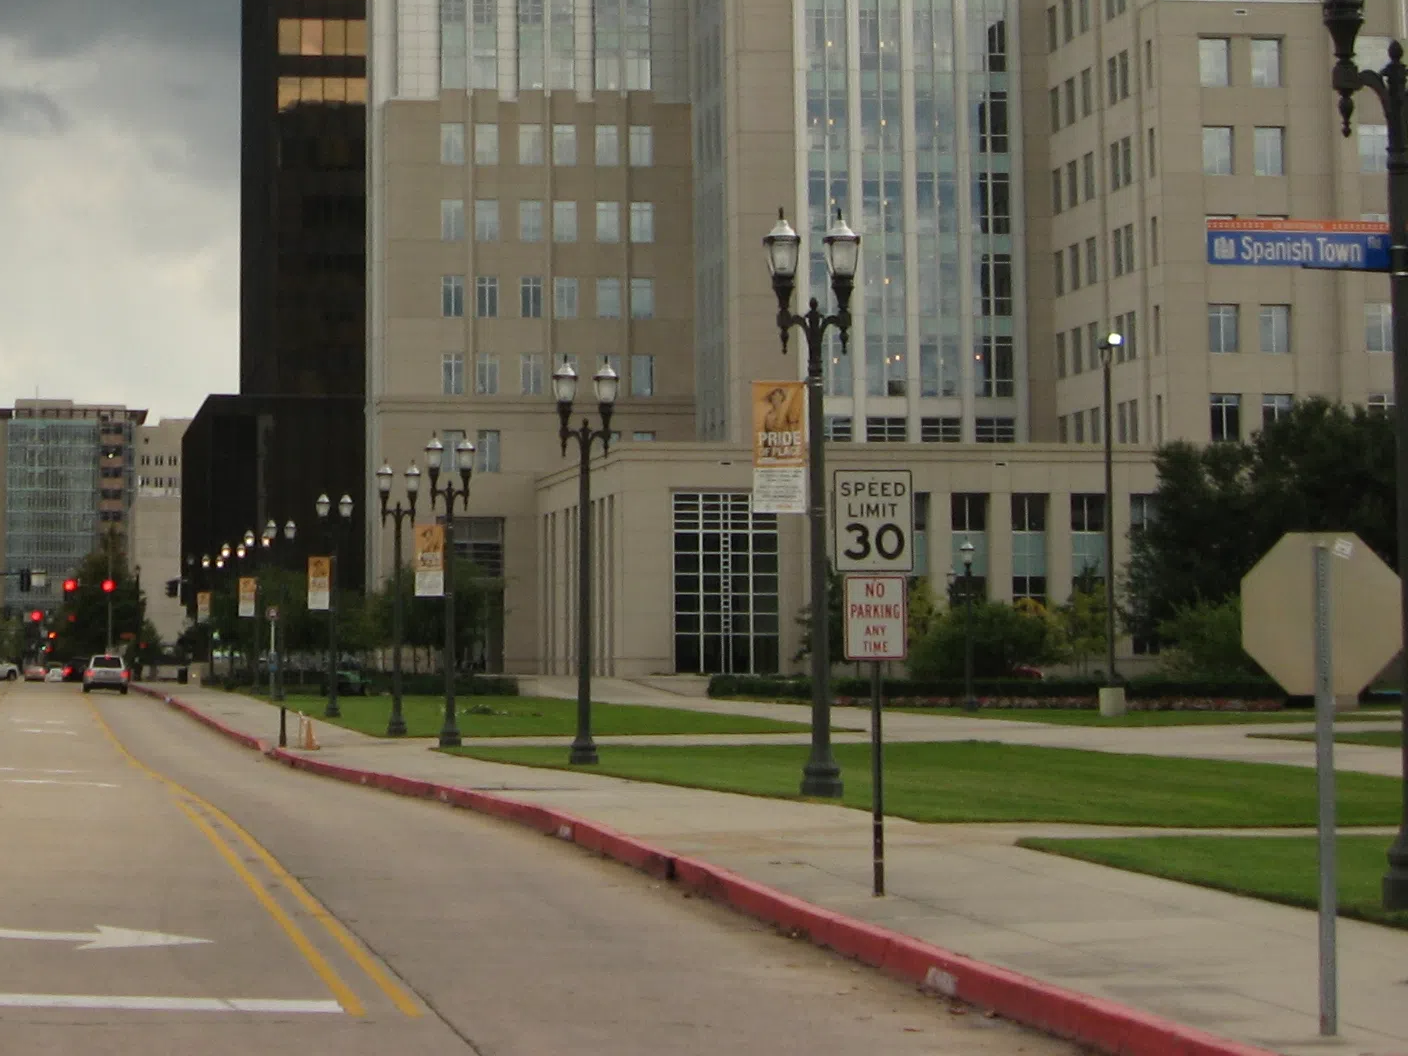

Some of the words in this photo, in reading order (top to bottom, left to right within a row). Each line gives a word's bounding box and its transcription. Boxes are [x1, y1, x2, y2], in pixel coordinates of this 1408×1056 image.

[1241, 235, 1313, 263] Spanish
[1316, 237, 1362, 263] Town
[758, 431, 802, 446] PRIDE
[840, 482, 906, 497] SPEED
[848, 503, 897, 518] LIMIT
[844, 523, 905, 560] 30
[865, 583, 885, 598] NO
[850, 604, 901, 619] PARKING
[864, 625, 887, 636] ANY
[863, 641, 888, 653] TIME
